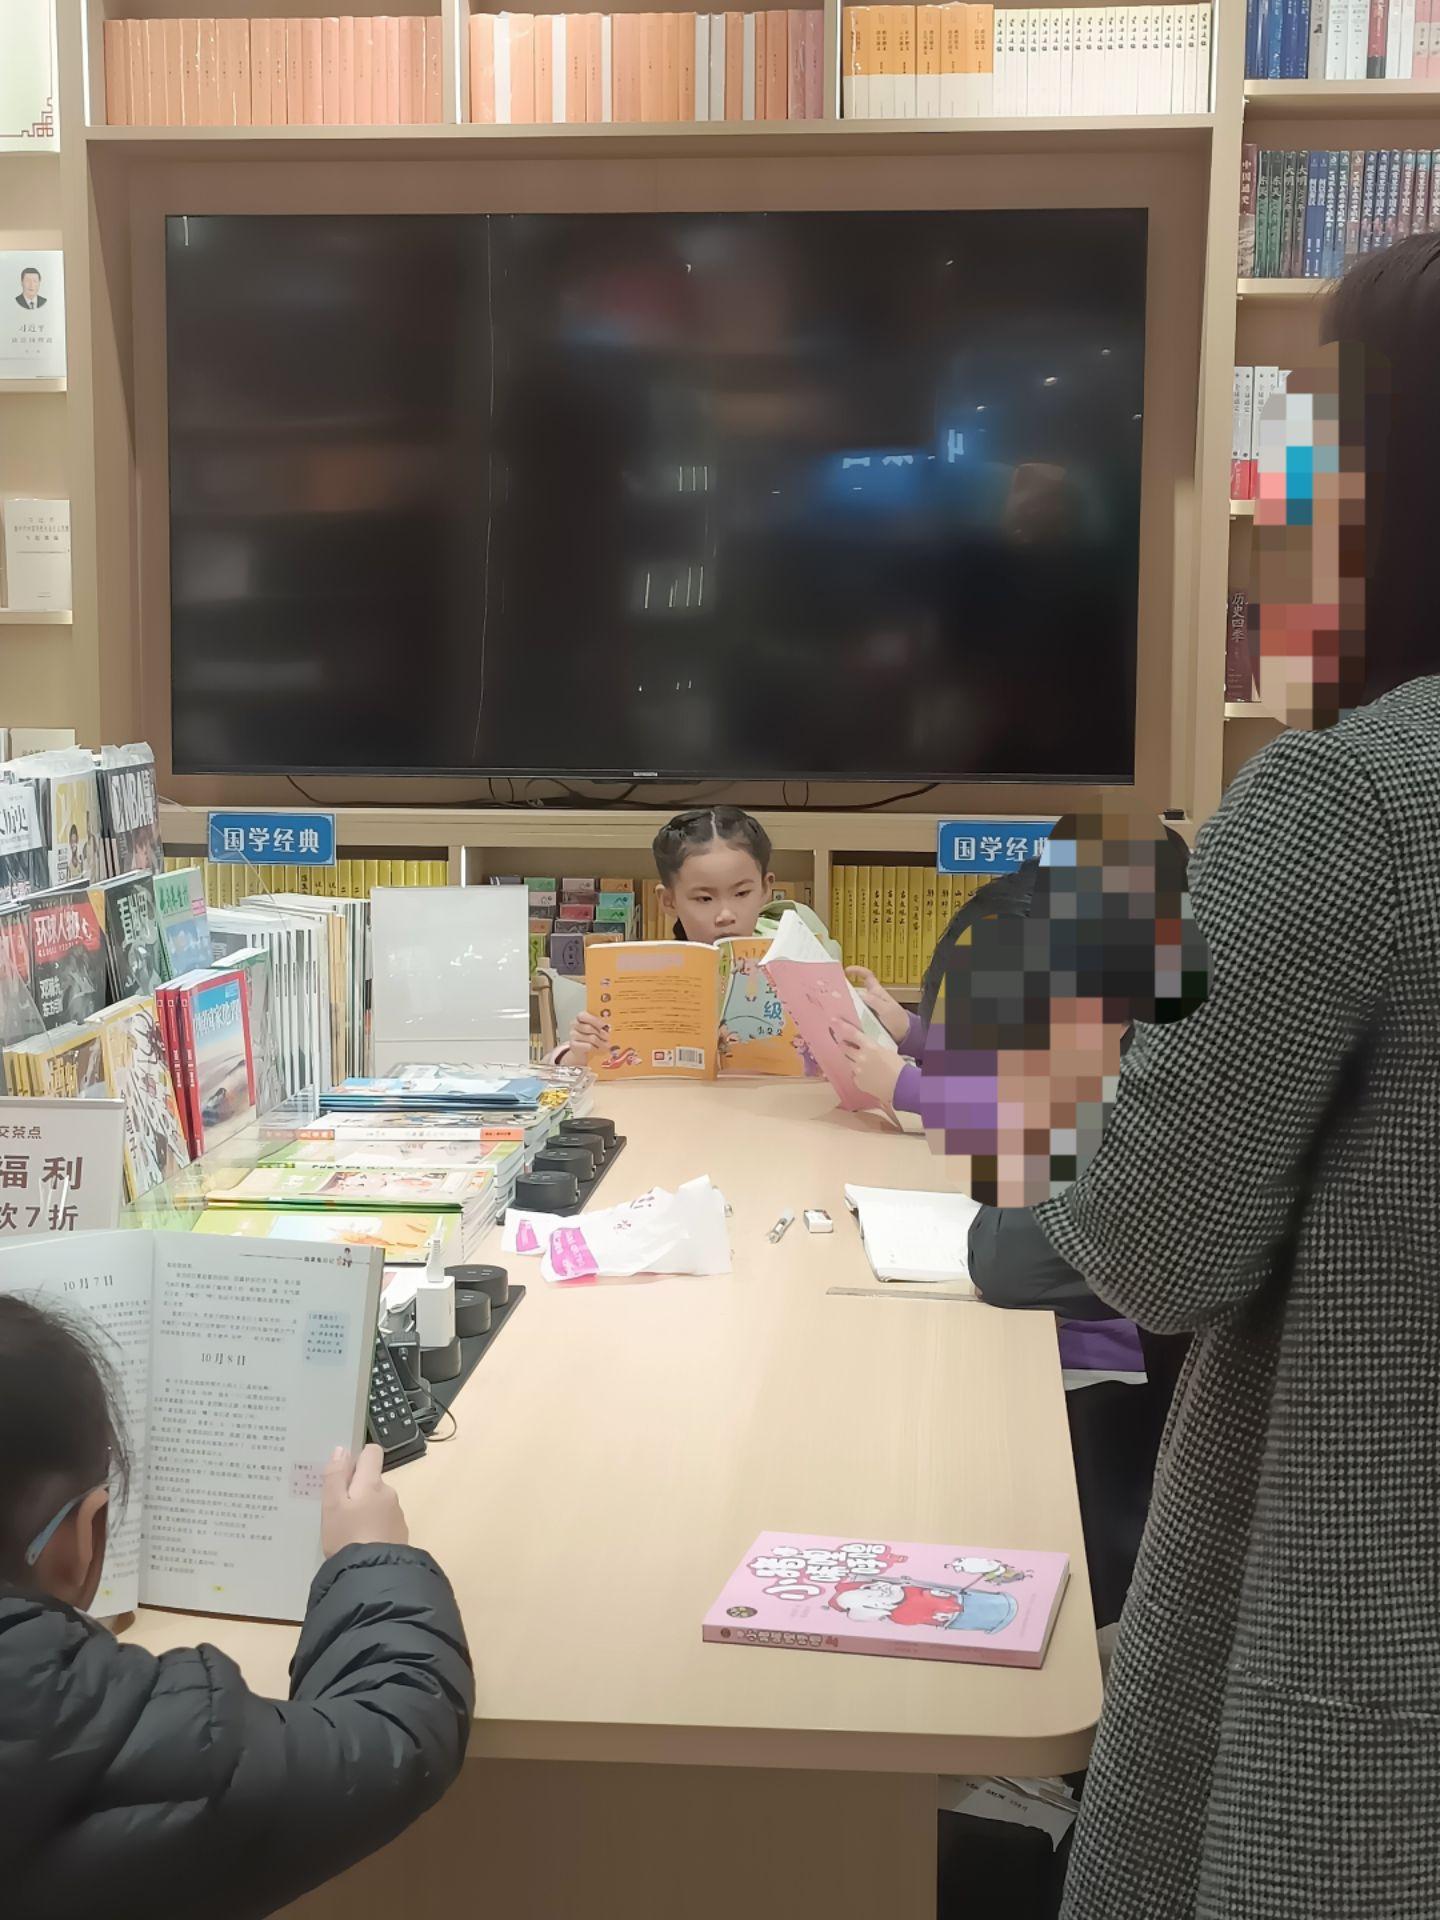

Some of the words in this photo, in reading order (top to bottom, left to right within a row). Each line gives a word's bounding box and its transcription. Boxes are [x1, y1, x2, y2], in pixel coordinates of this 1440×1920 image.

[0, 804, 28, 836] 历史
[223, 827, 319, 854] 国学经典
[0, 1126, 41, 1139] 交茶点
[0, 1154, 83, 1190] 福利
[64, 1274, 114, 1292] 10月7日
[200, 1351, 247, 1367] 10月8日
